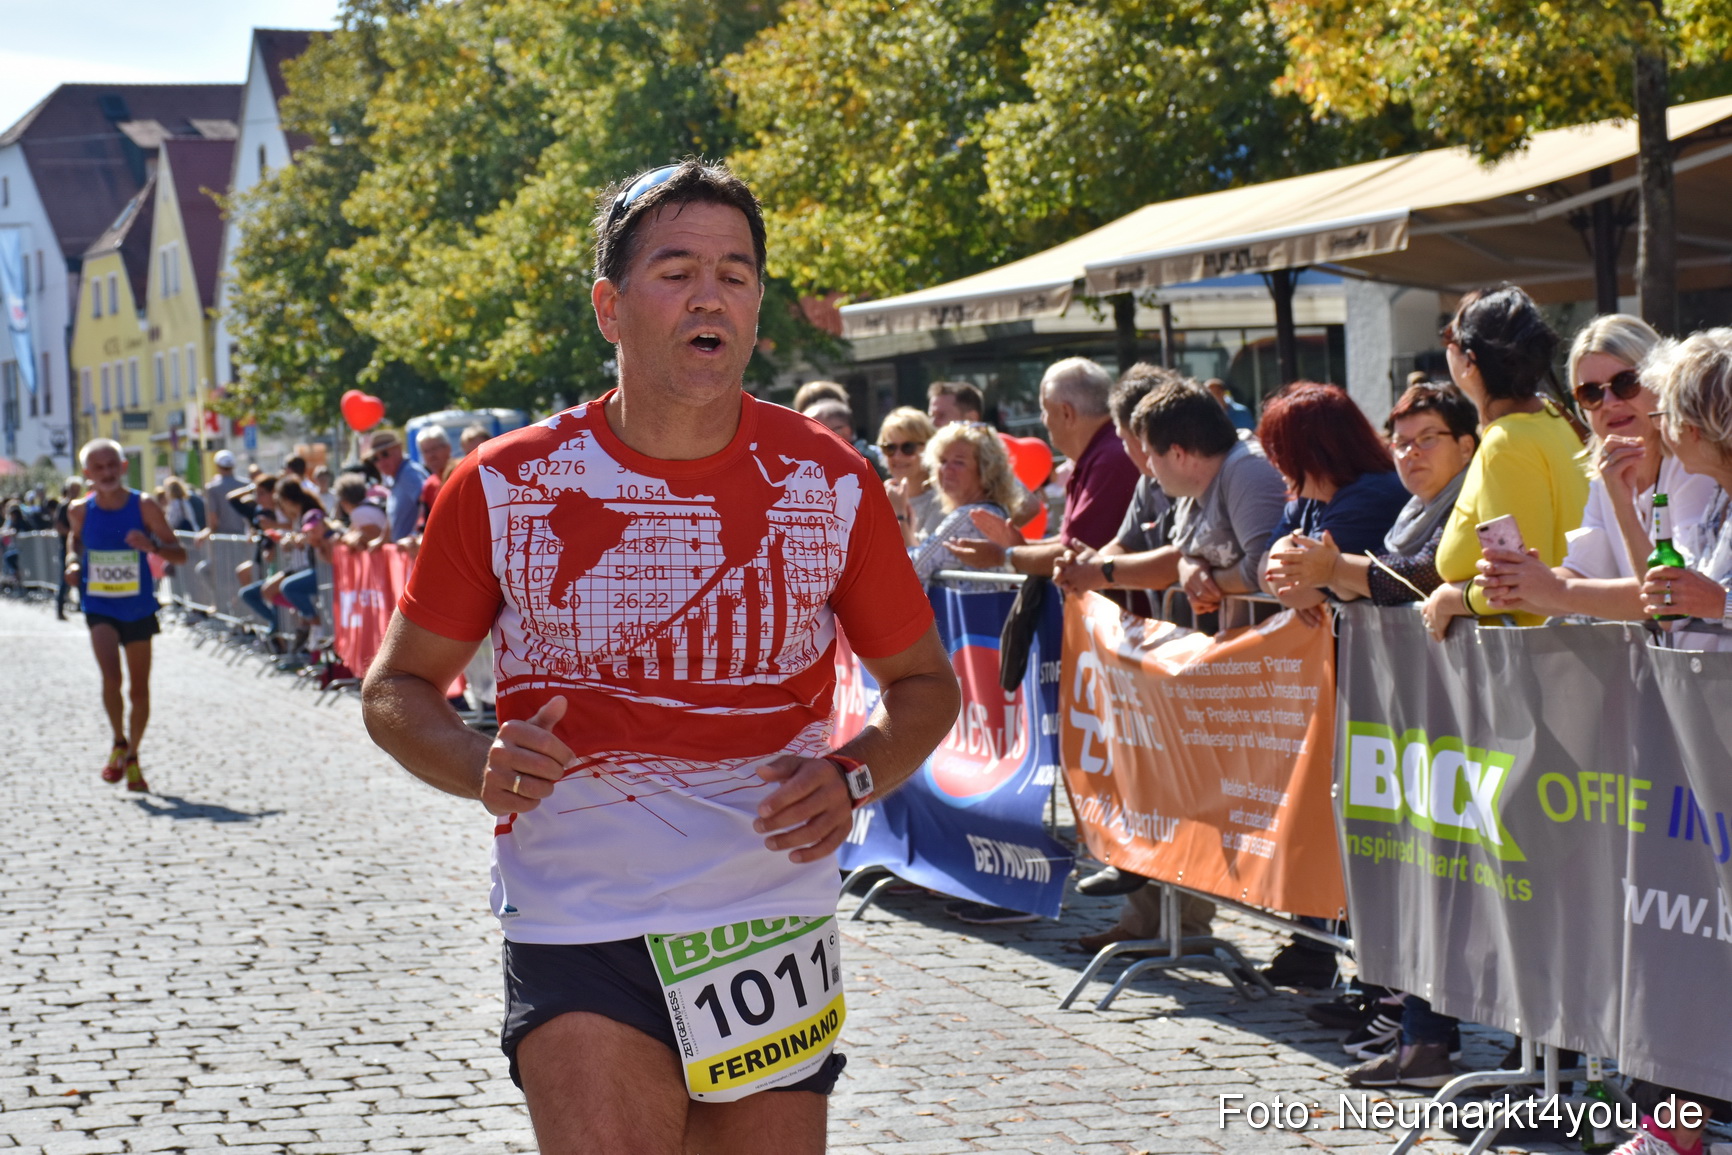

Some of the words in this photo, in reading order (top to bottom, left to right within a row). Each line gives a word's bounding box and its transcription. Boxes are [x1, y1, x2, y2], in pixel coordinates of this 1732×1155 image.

[616, 484, 667, 500] 10.54
[96, 566, 136, 581] 1006
[614, 565, 669, 581] 52.01
[613, 592, 669, 609] 26.22
[1263, 655, 1304, 674] Partner
[1246, 681, 1266, 699] und
[1206, 706, 1250, 727] Projekte
[1349, 734, 1504, 846] BOCK
[694, 938, 829, 1039] 1011
[708, 1008, 838, 1085] FERDINAND
